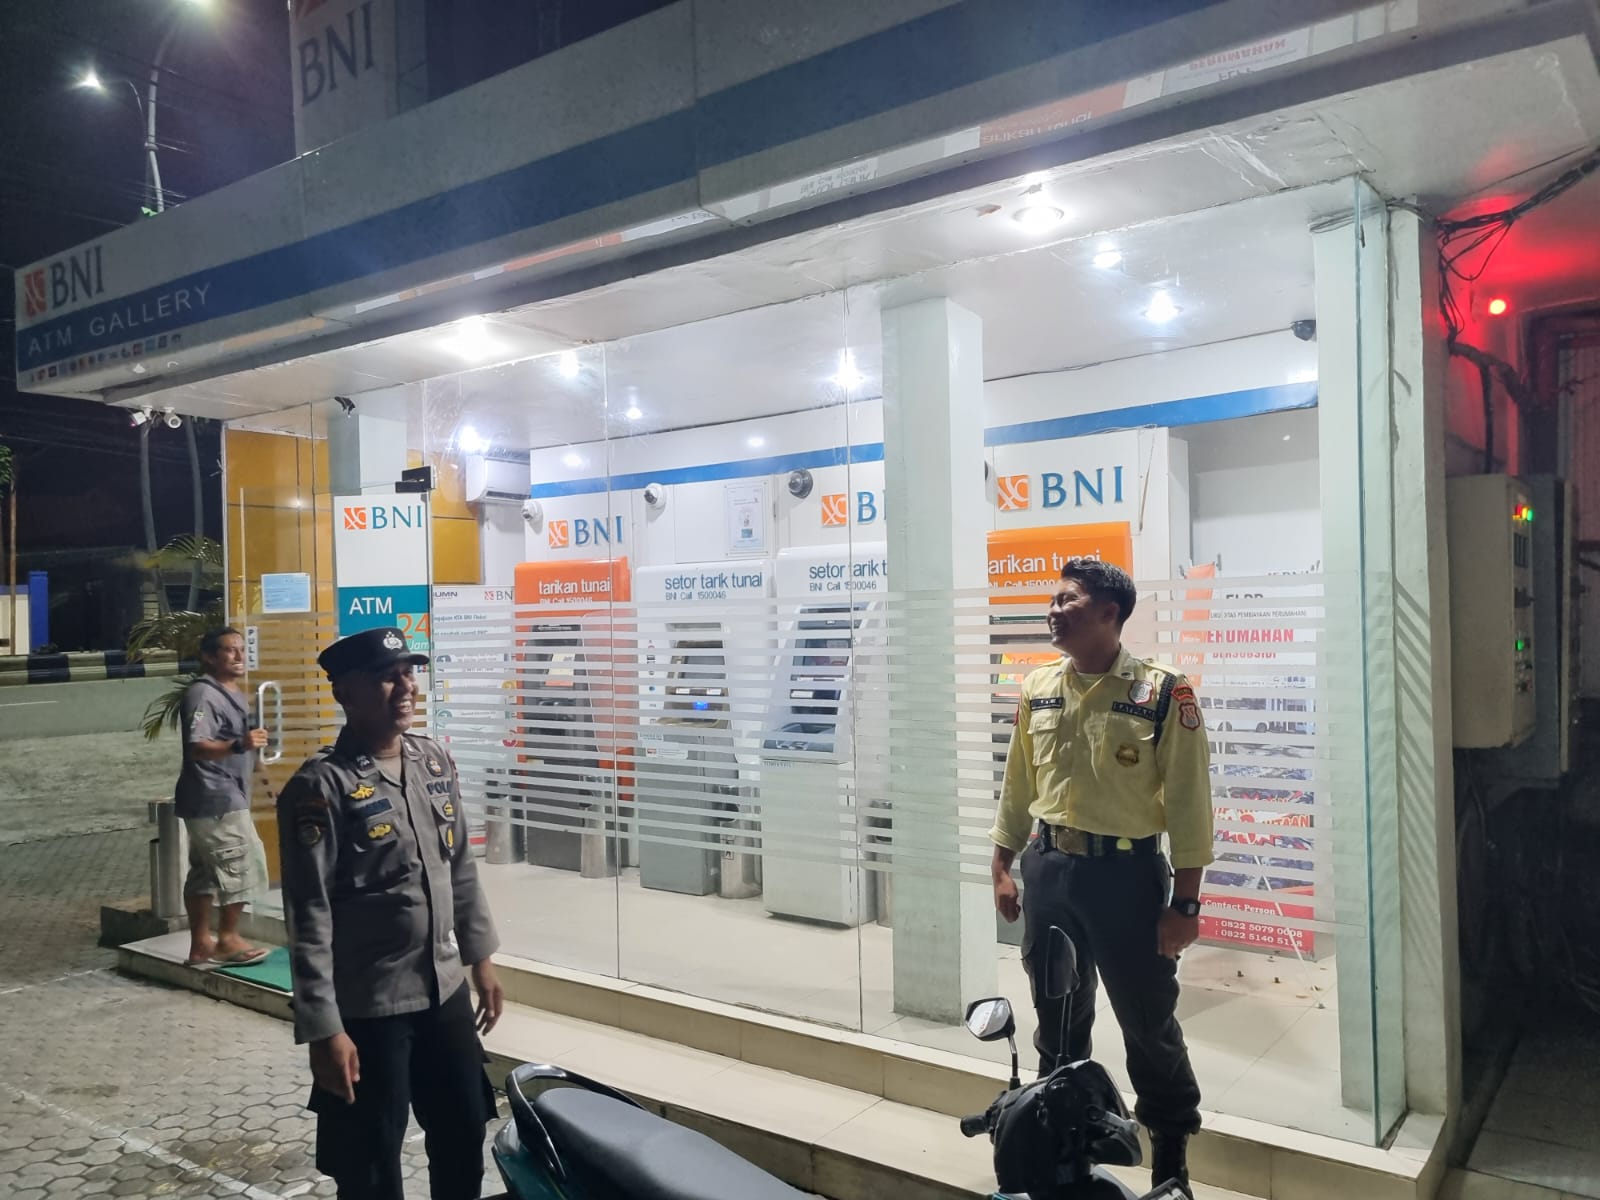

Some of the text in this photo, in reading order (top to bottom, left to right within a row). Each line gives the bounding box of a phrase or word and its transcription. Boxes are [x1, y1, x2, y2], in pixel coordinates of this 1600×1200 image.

[298, 1, 374, 107] BNI
[50, 246, 104, 308] BNI
[28, 327, 72, 356] ATM
[89, 283, 212, 336] GALLERY
[1042, 466, 1123, 508] BNI
[372, 505, 423, 529] BNI
[575, 515, 623, 546] BNI
[809, 562, 845, 579] setor
[848, 560, 879, 577] arik
[988, 554, 1046, 574] arikan
[538, 577, 610, 595] tarikan tunai
[665, 571, 762, 590] setor tarik tunai
[809, 582, 822, 592] BNI
[349, 596, 393, 614] ATM
[496, 590, 513, 601] BN
[665, 592, 677, 600] BNI
[398, 613, 431, 639] 24
[1207, 628, 1294, 643] ERUMAHAN
[1205, 899, 1275, 916] Contact Person
[1221, 920, 1246, 929] 0822
[1249, 923, 1274, 933] 5079
[1221, 930, 1246, 939] 0822
[1249, 933, 1274, 943] 5140
